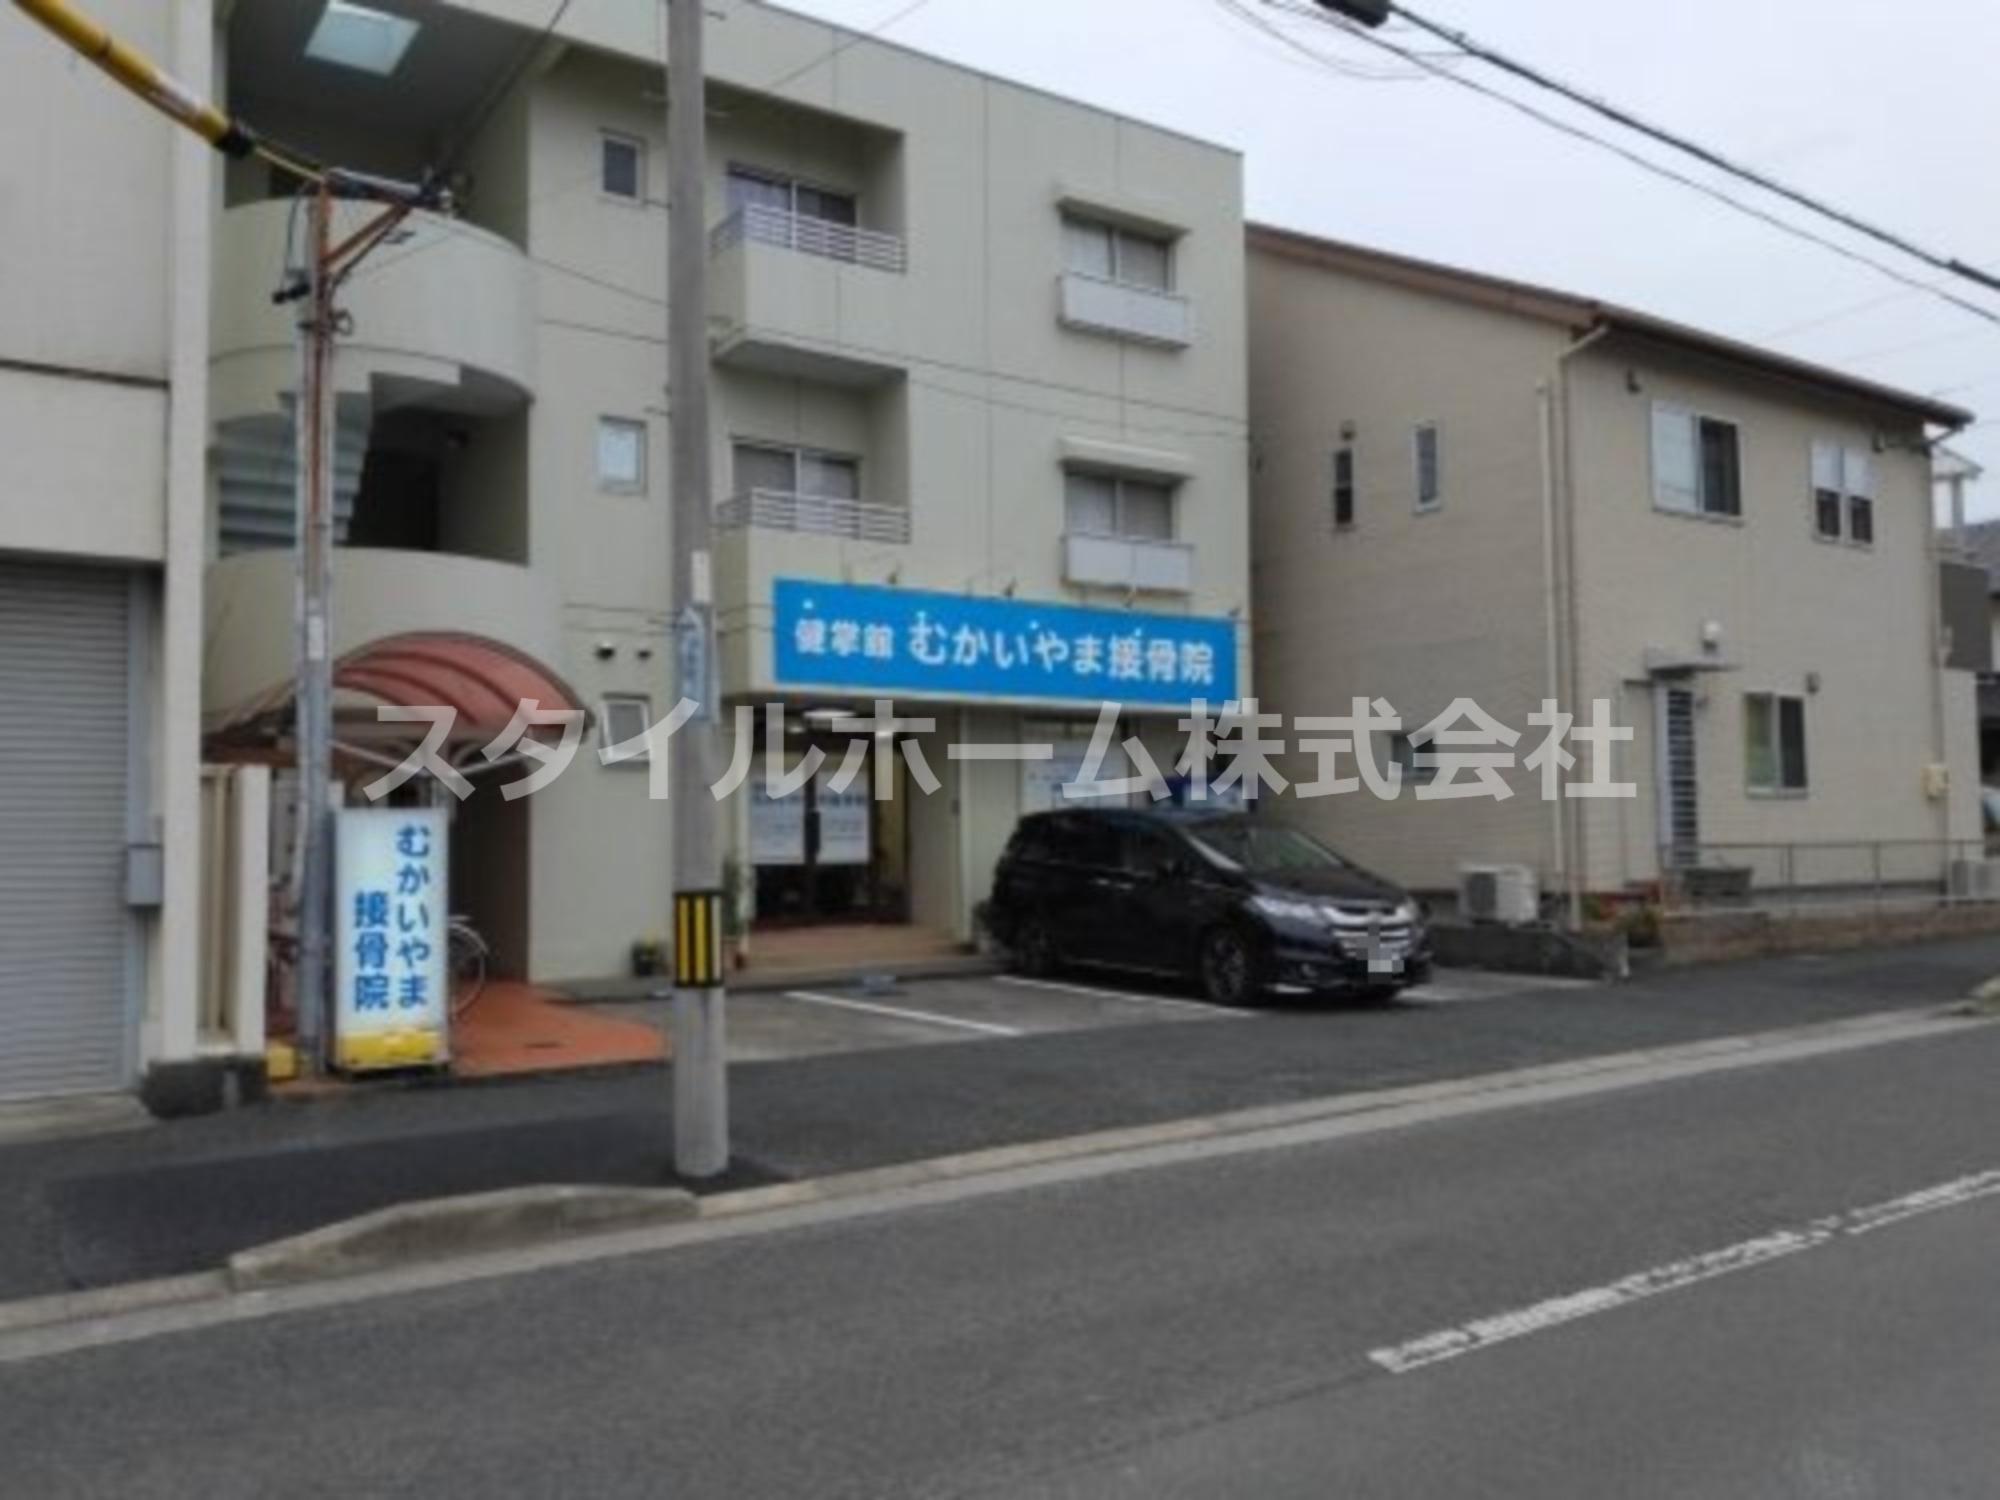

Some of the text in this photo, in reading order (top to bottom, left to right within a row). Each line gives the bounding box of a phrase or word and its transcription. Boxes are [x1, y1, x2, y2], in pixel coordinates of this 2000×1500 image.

[908, 613, 1215, 685] むかいやま接骨院
[354, 891, 390, 1011] 接骨院
[396, 825, 431, 1009] むかいやま
